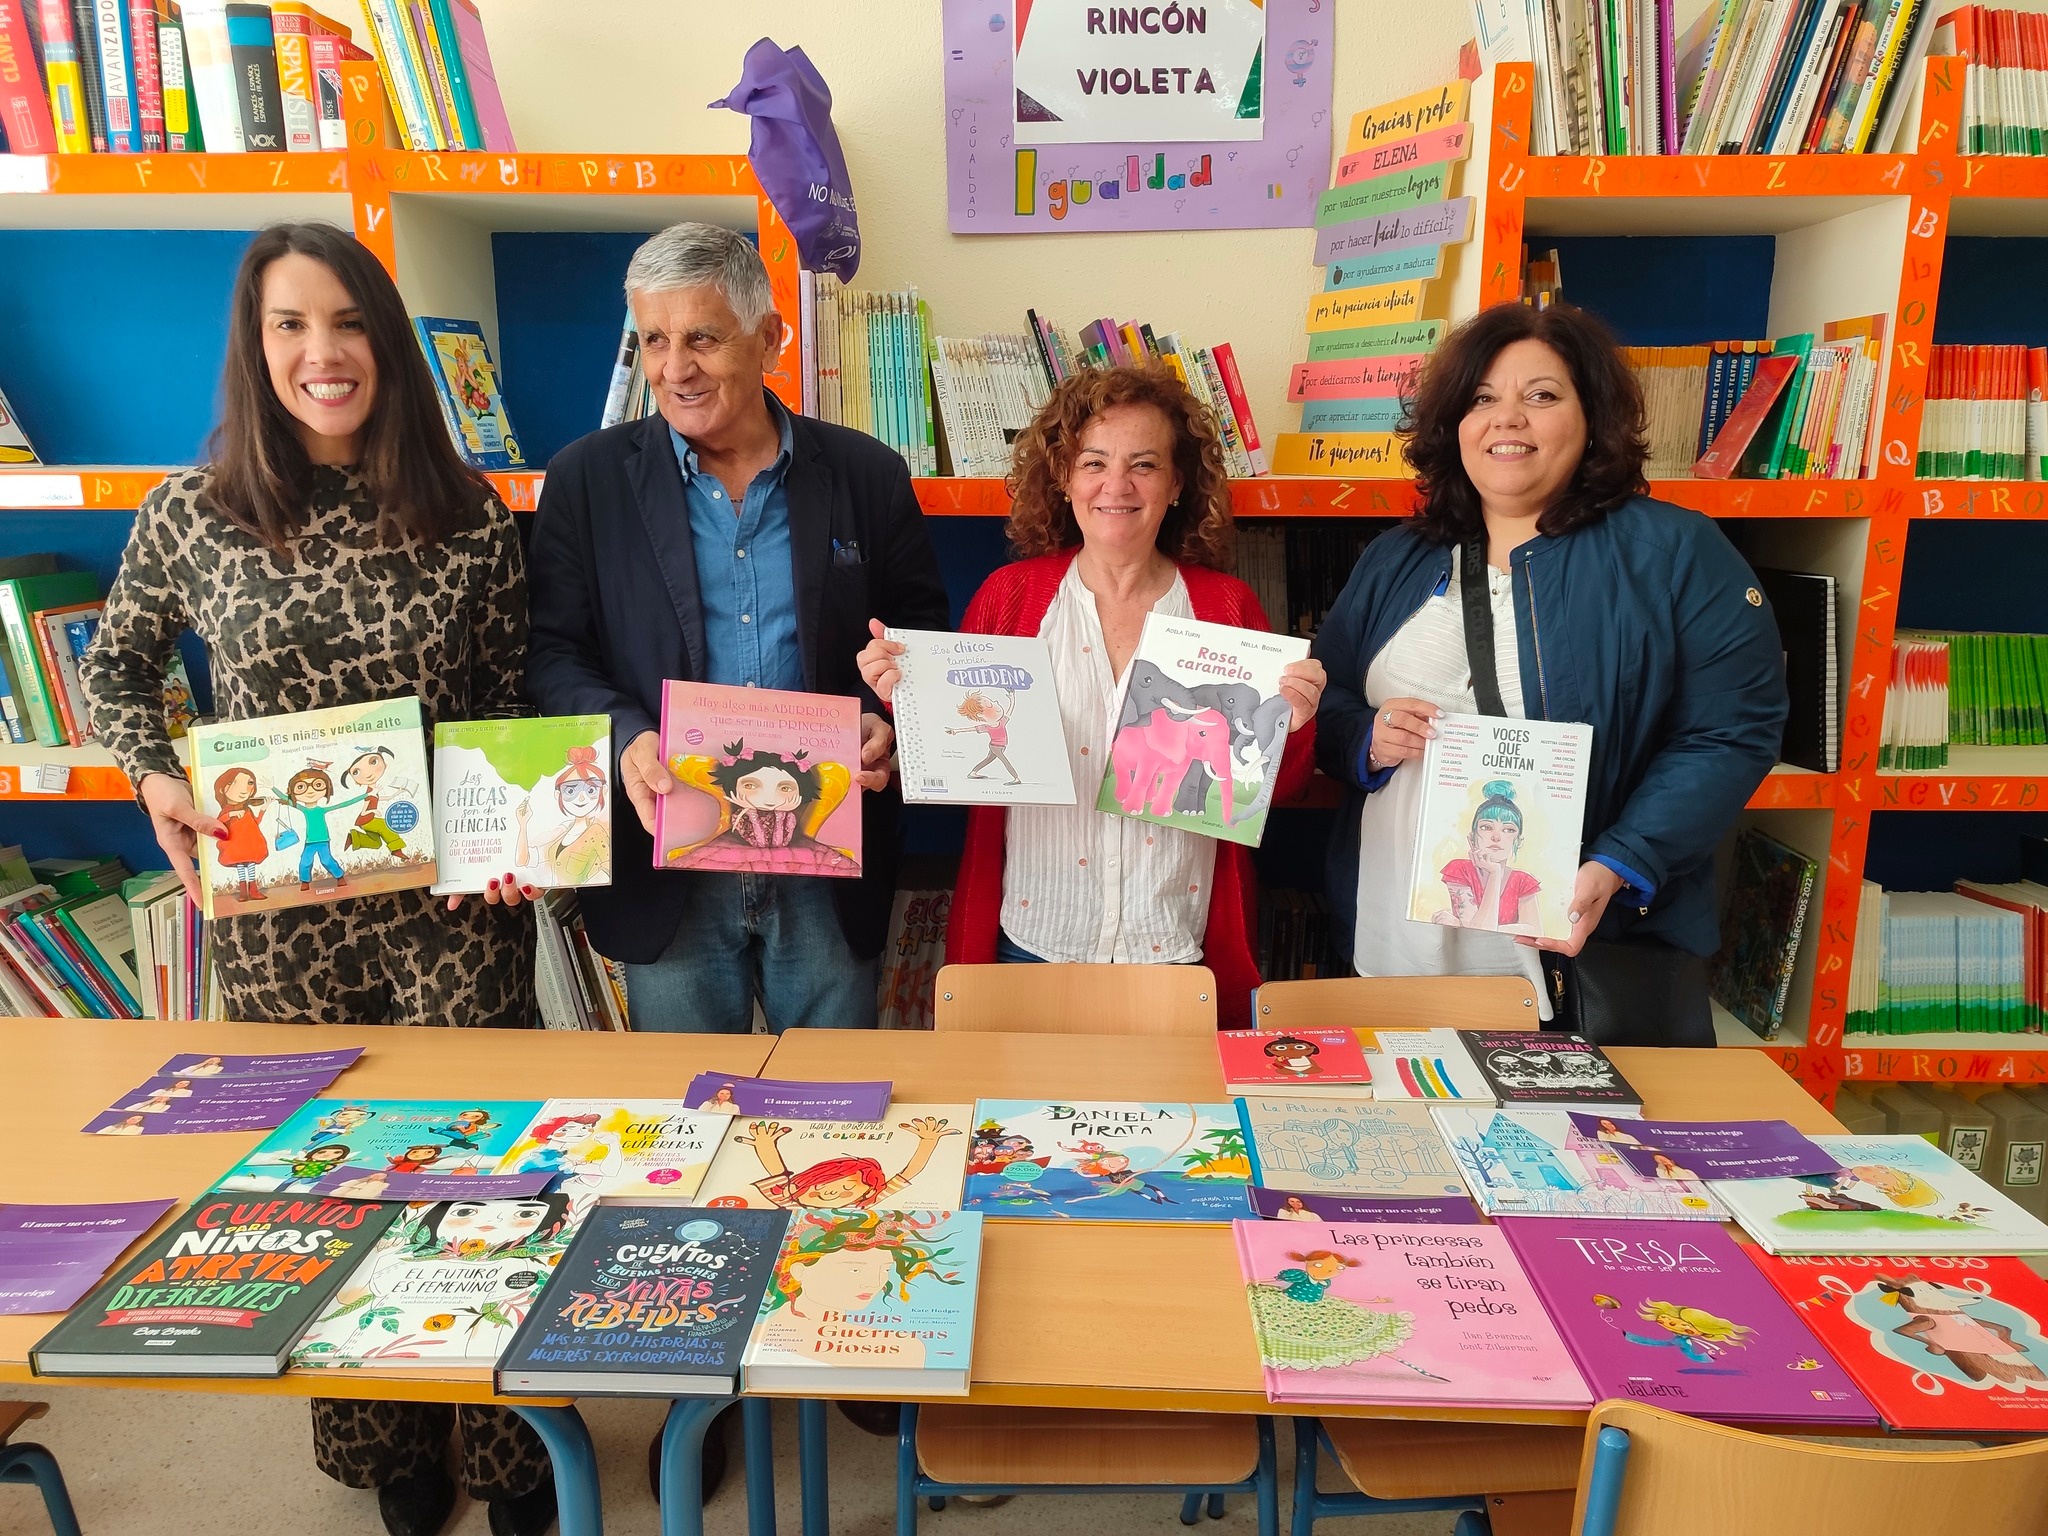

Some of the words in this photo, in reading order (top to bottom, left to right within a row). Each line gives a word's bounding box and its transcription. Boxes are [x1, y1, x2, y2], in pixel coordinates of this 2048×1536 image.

[1087, 2, 1207, 34] RINCÓN
[101, 0, 125, 92] AVANZADO
[161, 30, 172, 86] ACTUAL
[280, 37, 309, 131] SPANISH
[1077, 68, 1216, 95] VIOLETA
[1362, 111, 1413, 140] Gracias
[1416, 87, 1454, 133] profe
[249, 134, 277, 148] VOX
[966, 112, 978, 219] IGUALDAD
[1373, 143, 1418, 171] ELENA
[808, 182, 828, 202] NO
[1014, 149, 1213, 220] Igualdad
[1324, 201, 1337, 215] por
[1340, 194, 1369, 208] valorar
[1371, 185, 1406, 202] nuestros
[1407, 174, 1440, 200] logros
[1330, 240, 1344, 255] por
[1348, 233, 1373, 248] hacer
[1373, 218, 1400, 248] fácil
[1400, 225, 1410, 239] lo
[1413, 216, 1448, 237] difícil
[1343, 270, 1355, 282] por
[1356, 263, 1394, 279] ayudarnos
[1403, 255, 1436, 270] madurar
[1316, 305, 1328, 322] por
[1332, 299, 1342, 315] tu
[1343, 298, 1382, 319] paciencia
[1383, 289, 1416, 312] infinita
[1316, 344, 1325, 354] por
[1326, 341, 1355, 352] ayudarnos
[1361, 337, 1391, 348] descubrir
[1391, 331, 1399, 344] el
[1400, 329, 1426, 344] mundo
[1305, 377, 1317, 389] por
[1320, 374, 1360, 386] dedicarnos
[1363, 366, 1373, 384] tu
[1377, 362, 1406, 390] tiempo
[1714, 359, 1723, 387] TEATRO
[1712, 389, 1719, 398] DE
[1315, 413, 1327, 423] por
[1329, 412, 1359, 422] apreciar
[1361, 411, 1390, 421] nuestro
[1309, 439, 1326, 461] ¡Te
[1329, 439, 1391, 467] queremos!
[930, 644, 950, 655] Los
[954, 640, 994, 653] chicos
[1197, 646, 1237, 665] Rosa
[1241, 640, 1259, 650] NELLA
[1262, 644, 1282, 654] BOSNIA
[947, 656, 995, 665] también...
[1177, 657, 1253, 681] caramelo
[953, 668, 1026, 686] ¡PUEDEN!
[693, 696, 719, 710] ¿Hay
[723, 700, 746, 713] algo
[749, 703, 770, 712] más
[772, 704, 840, 718] ABURRIDO
[213, 737, 265, 753] Cuando
[269, 733, 289, 744] las
[293, 729, 327, 741] niñas
[330, 723, 373, 736] vuelan
[376, 716, 402, 729] alto
[709, 717, 733, 727] que
[735, 717, 754, 726] ser
[756, 719, 775, 729] una
[778, 721, 840, 734] PRINCESA
[799, 737, 841, 749] ROSA?
[1493, 727, 1530, 743] VOCES
[1498, 742, 1521, 756] QUE
[1482, 754, 1534, 771] CUENTAN
[460, 770, 483, 786] Las
[446, 786, 508, 807] CHICAS
[461, 809, 479, 818] son
[483, 805, 496, 815] de
[445, 816, 507, 834] CIENCIAS
[1776, 973, 1791, 1013] GUINNESS
[1785, 940, 1799, 973] WORLD
[1793, 898, 1809, 939] RECORDS
[1802, 878, 1813, 897] 2022
[1225, 1030, 1286, 1038] TERESA
[1479, 1040, 1520, 1048] CHICAS
[1524, 1042, 1594, 1052] MODERNAS
[1042, 1105, 1175, 1122] DANIELA
[1262, 1103, 1280, 1113] La
[1286, 1104, 1329, 1114] Peluca
[1335, 1106, 1348, 1114] de
[1355, 1106, 1397, 1116] LUCA
[625, 1124, 697, 1135] CHICAS
[1071, 1122, 1153, 1138] PIRATA
[621, 1141, 704, 1150] GUERRERAS
[196, 1198, 383, 1229] CUENTOS
[224, 1222, 272, 1234] PARA
[166, 1226, 334, 1259] NIÑOS
[323, 1238, 354, 1252] Que
[1329, 1229, 1370, 1246] Las
[1371, 1230, 1484, 1251] princesas
[616, 1241, 729, 1269] CUENTOS
[1556, 1236, 1716, 1267] TERESA
[127, 1252, 334, 1286] ATREVEN
[1404, 1252, 1495, 1270] también
[1604, 1264, 1616, 1272] no
[1621, 1264, 1654, 1275] quiere
[1659, 1264, 1673, 1273] ser
[1678, 1264, 1722, 1274] princesa
[1930, 1257, 1989, 1269] OSO
[404, 1267, 425, 1280] EL
[432, 1265, 503, 1280] FUTURO
[596, 1273, 621, 1289] PARA
[607, 1264, 661, 1278] BUENAS
[666, 1266, 719, 1280] NOCHES
[391, 1280, 410, 1294] ES
[416, 1278, 499, 1294] FEMENINO
[605, 1275, 714, 1306] NIÑAS
[1417, 1276, 1442, 1290] se
[1445, 1274, 1506, 1293] tiran
[104, 1283, 301, 1312] DIFERENTES
[558, 1290, 746, 1333] REBELDES
[822, 1310, 903, 1326] Brujas
[1445, 1299, 1518, 1321] pedos
[541, 1332, 569, 1346] MÁS
[572, 1335, 590, 1345] DE
[593, 1332, 630, 1347] 100
[631, 1335, 709, 1350] HISTORIAS
[711, 1340, 726, 1350] DE
[817, 1325, 949, 1341] Guerreras
[527, 1347, 589, 1363] MUJERES
[814, 1340, 900, 1354] Diosas
